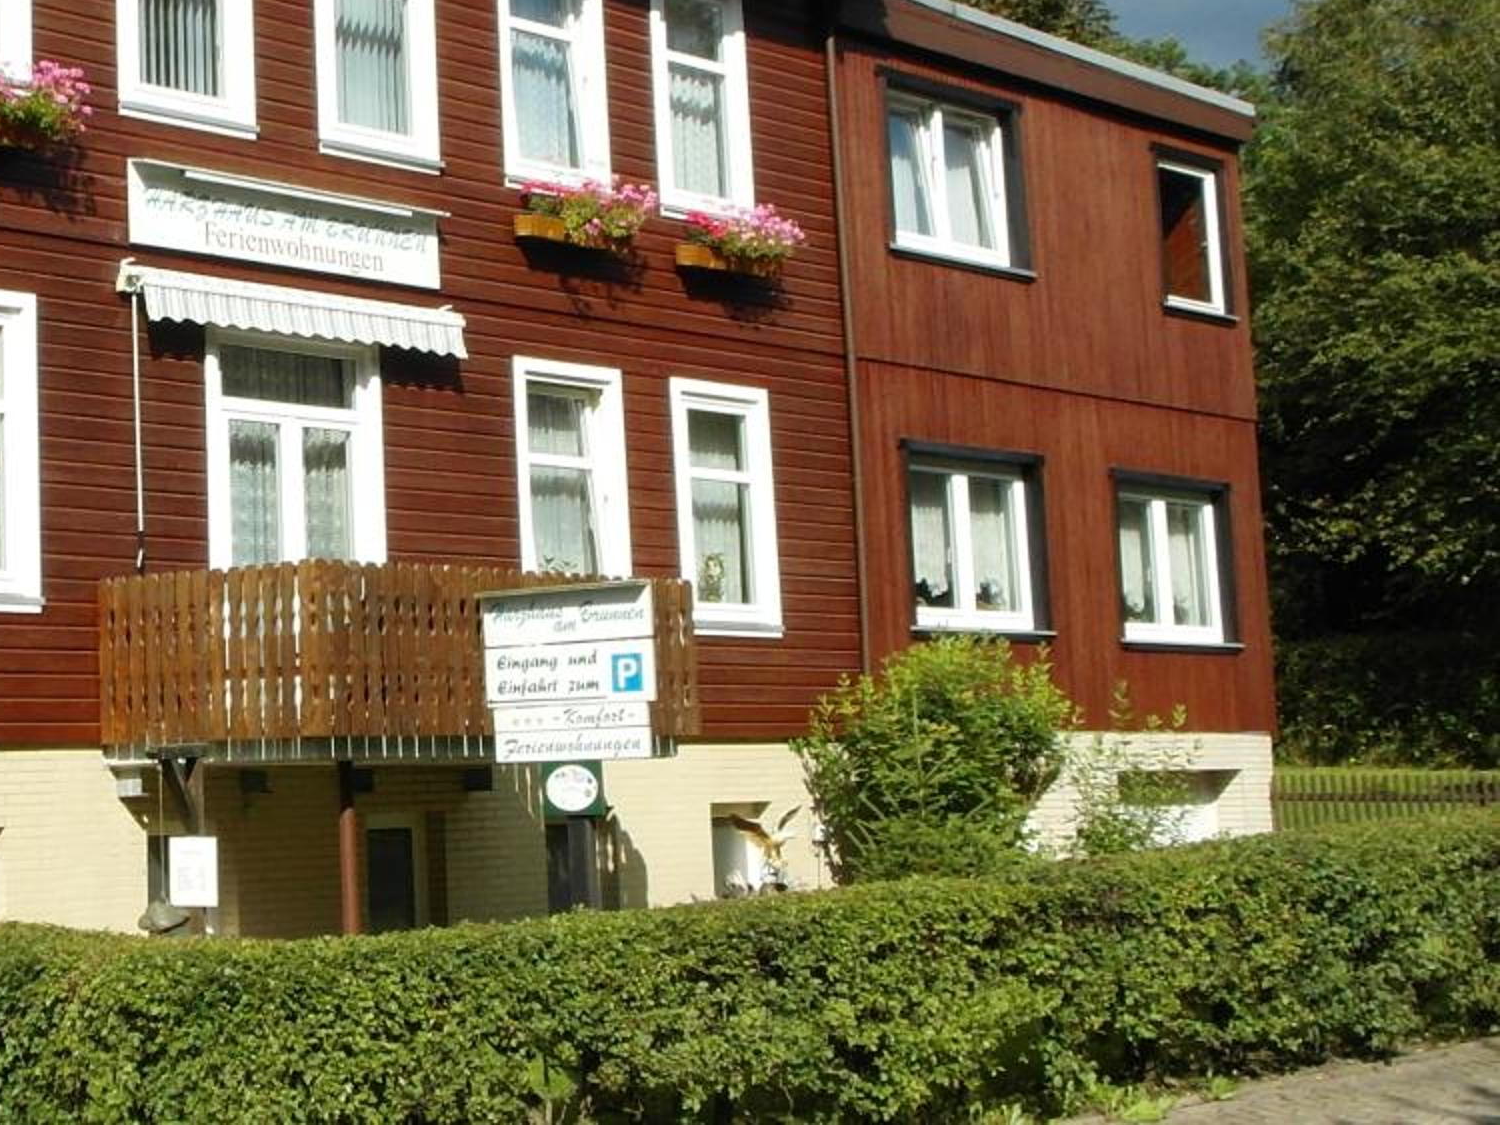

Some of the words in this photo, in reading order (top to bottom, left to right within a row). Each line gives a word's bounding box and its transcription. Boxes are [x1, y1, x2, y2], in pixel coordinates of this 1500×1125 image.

[204, 221, 384, 275] Ferienwohnungen
[553, 619, 577, 632] am
[579, 600, 645, 623] Brunnen
[497, 655, 558, 674] Eingang
[568, 648, 598, 666] und
[617, 658, 638, 688] P
[497, 678, 558, 697] Einfahrt
[569, 680, 599, 693] zum
[503, 733, 641, 760] Ferienwohnungen
